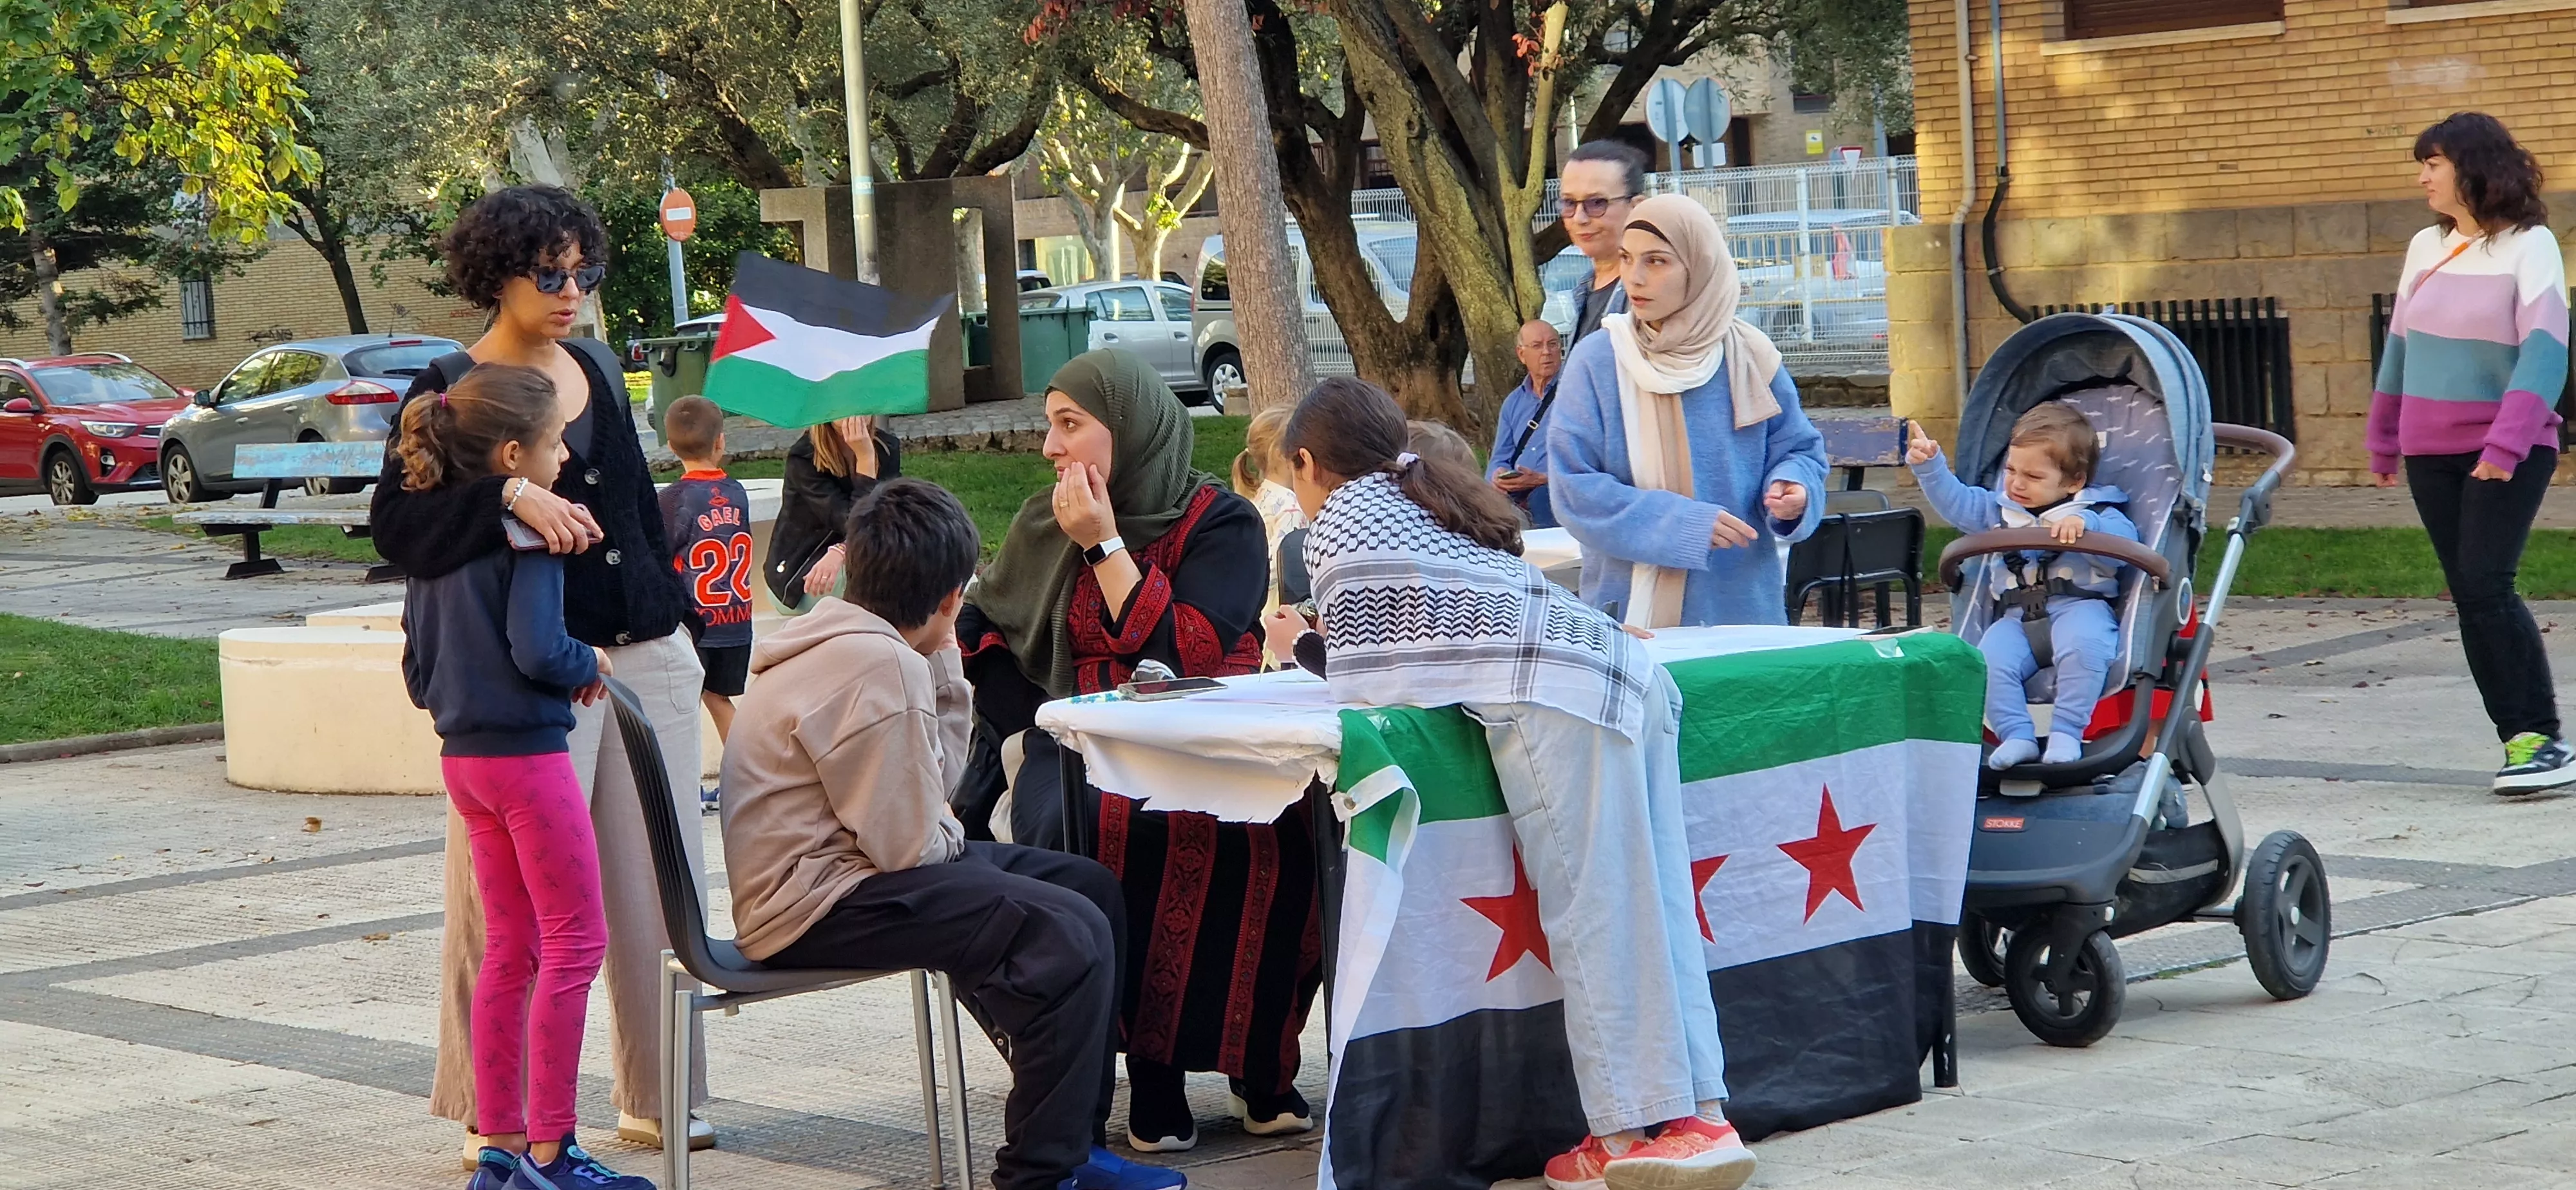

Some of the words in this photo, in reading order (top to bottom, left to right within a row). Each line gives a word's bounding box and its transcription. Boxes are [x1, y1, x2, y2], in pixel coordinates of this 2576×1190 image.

[697, 507, 740, 531] GAEL
[689, 532, 753, 606] 22
[1985, 819, 2022, 828] STOKKE
